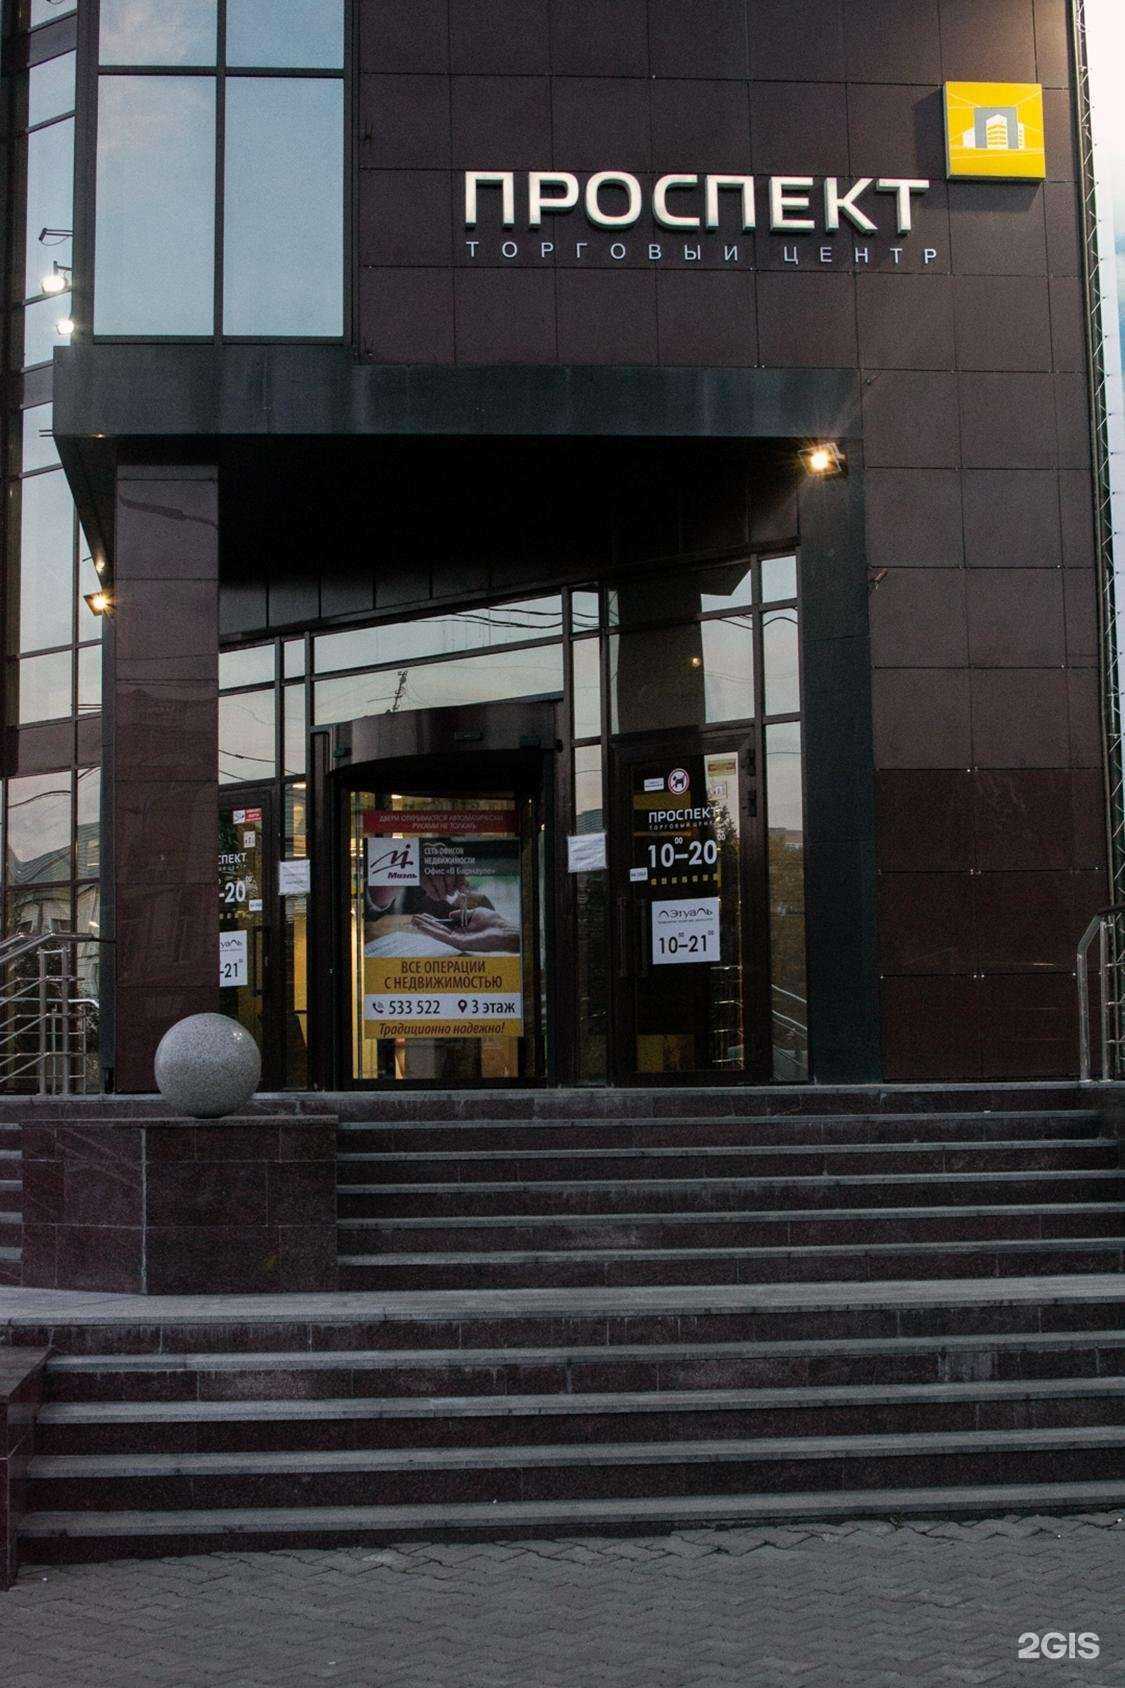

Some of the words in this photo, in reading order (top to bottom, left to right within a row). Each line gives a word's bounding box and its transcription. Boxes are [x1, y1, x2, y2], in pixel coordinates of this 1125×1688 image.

[464, 170, 930, 234] ПРОСПЕКТ
[783, 246, 938, 264] ЦЕНТР
[648, 806, 721, 823] ПРОСПЕКТ
[401, 960, 421, 974] ВСЕ
[424, 959, 486, 976] ОПЕРАЦИИ
[384, 975, 392, 989] С
[394, 975, 503, 990] НЕДВИЖИМОСТЬЮ
[388, 1000, 413, 1015] 533
[417, 1000, 441, 1014] 522
[471, 1000, 479, 1014] 3
[482, 1002, 516, 1013] этаж
[379, 1022, 451, 1037] Традиционно
[453, 1022, 505, 1035] надежно!
